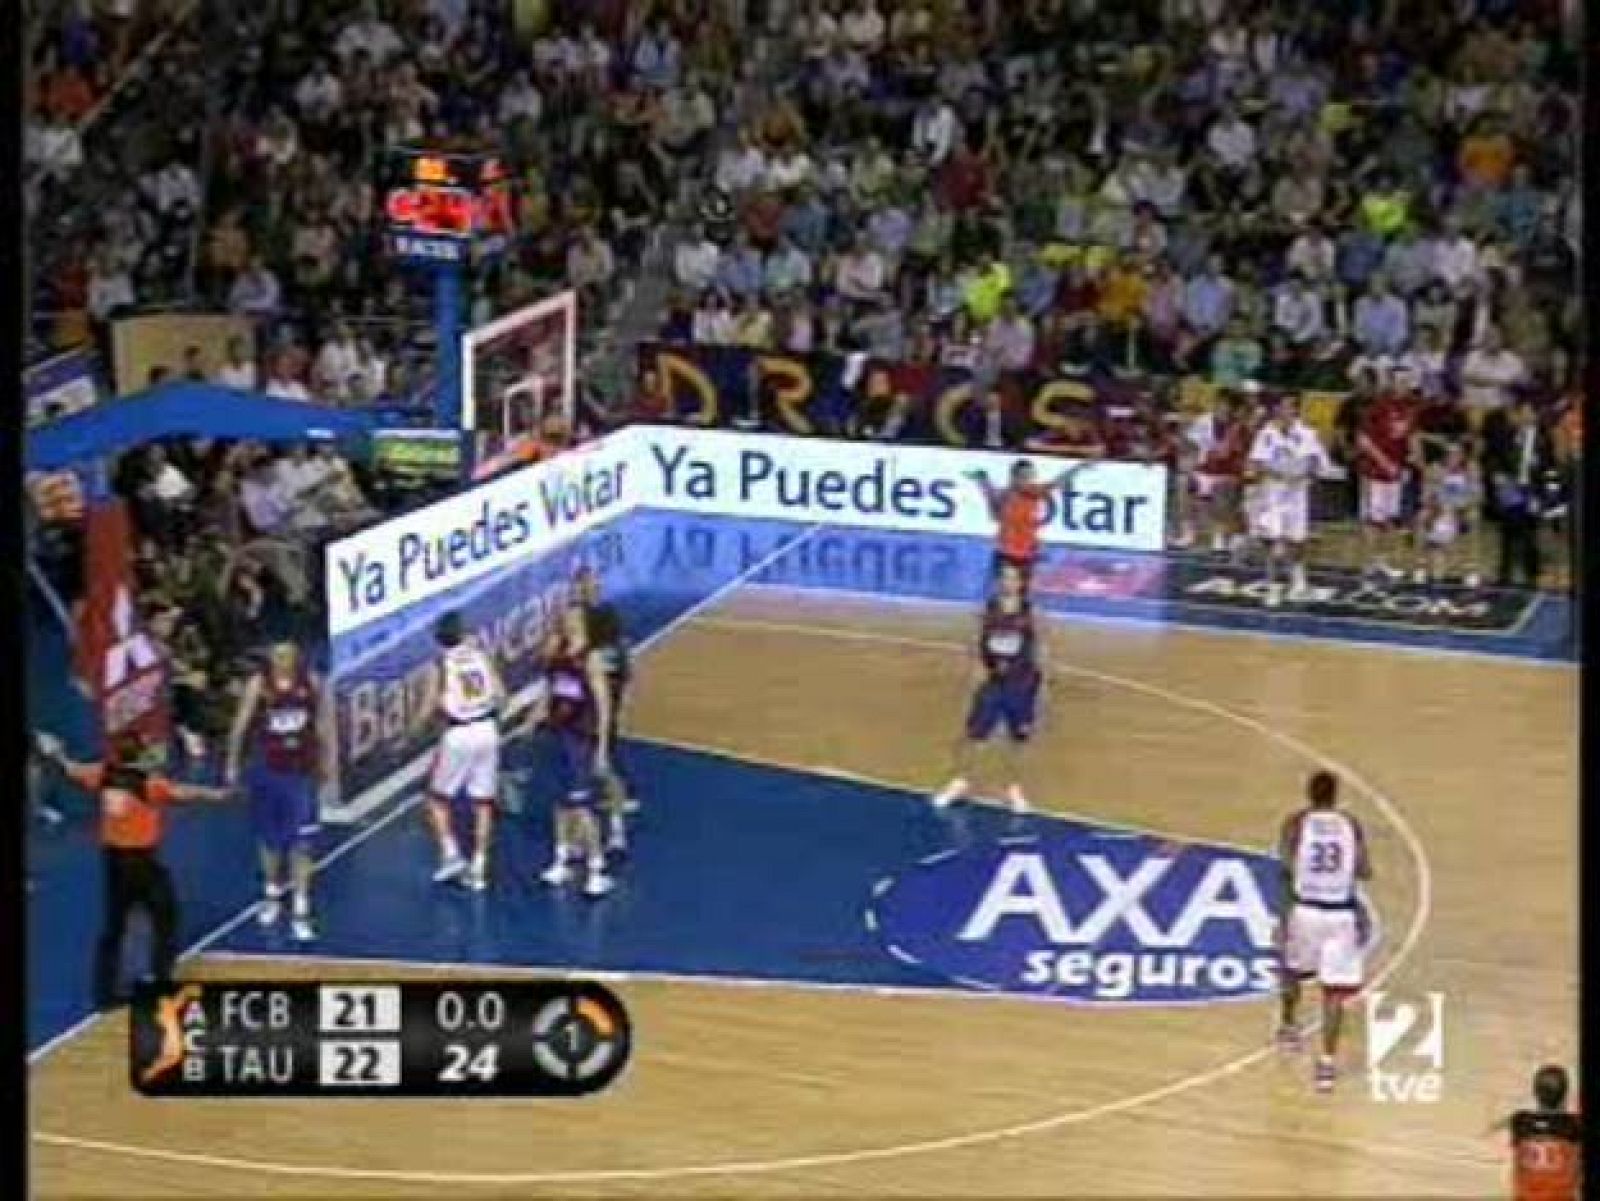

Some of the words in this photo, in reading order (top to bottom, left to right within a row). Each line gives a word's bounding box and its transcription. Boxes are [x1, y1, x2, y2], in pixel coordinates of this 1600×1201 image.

[650, 443, 716, 499] Ya
[739, 449, 956, 518] Puedes
[336, 551, 385, 613] Ya
[398, 500, 530, 592] Puedes
[538, 460, 628, 529] Votar
[1309, 841, 1342, 874] 33
[957, 852, 1280, 949] AXA
[1021, 948, 1280, 998] seguros
